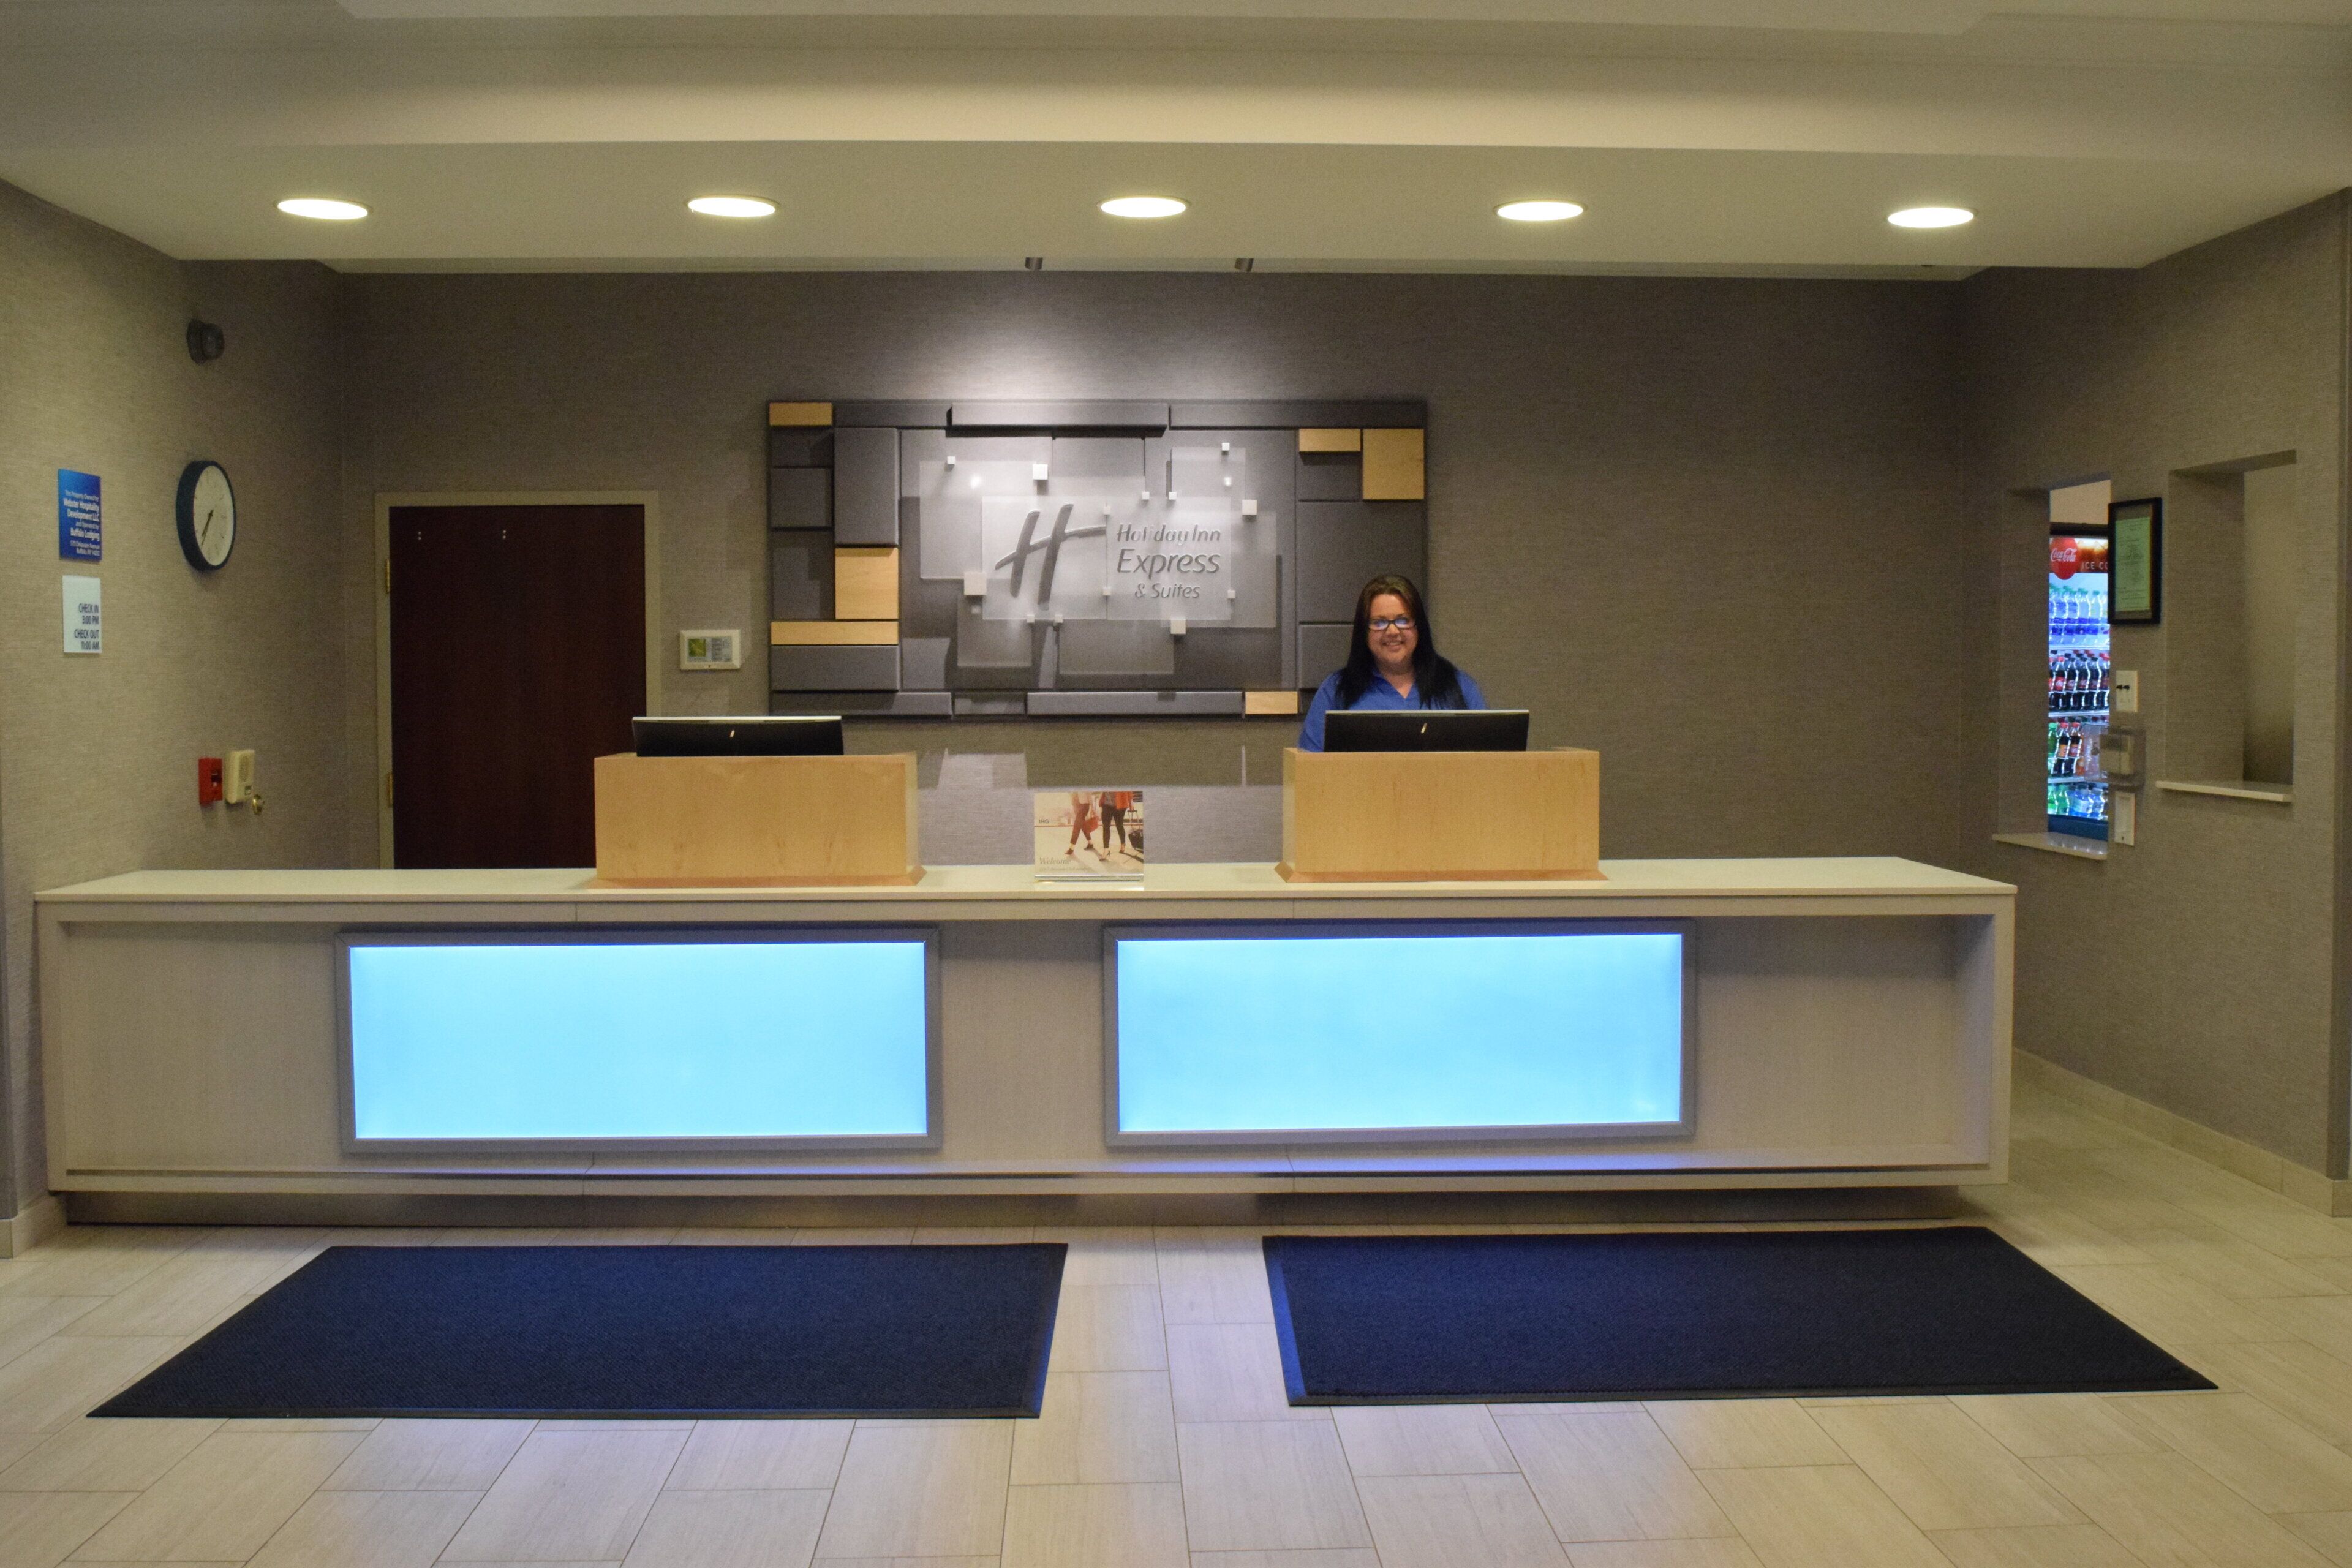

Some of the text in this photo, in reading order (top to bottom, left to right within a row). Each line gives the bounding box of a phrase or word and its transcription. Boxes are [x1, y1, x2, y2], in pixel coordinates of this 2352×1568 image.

[1117, 524, 1221, 546] Holiday Inn
[1117, 548, 1221, 580] Express
[1134, 583, 1200, 598] & Suites
[78, 603, 93, 613] CHECK
[92, 616, 99, 625] PM
[74, 629, 99, 639] CHECK OUT
[92, 641, 99, 650] AM
